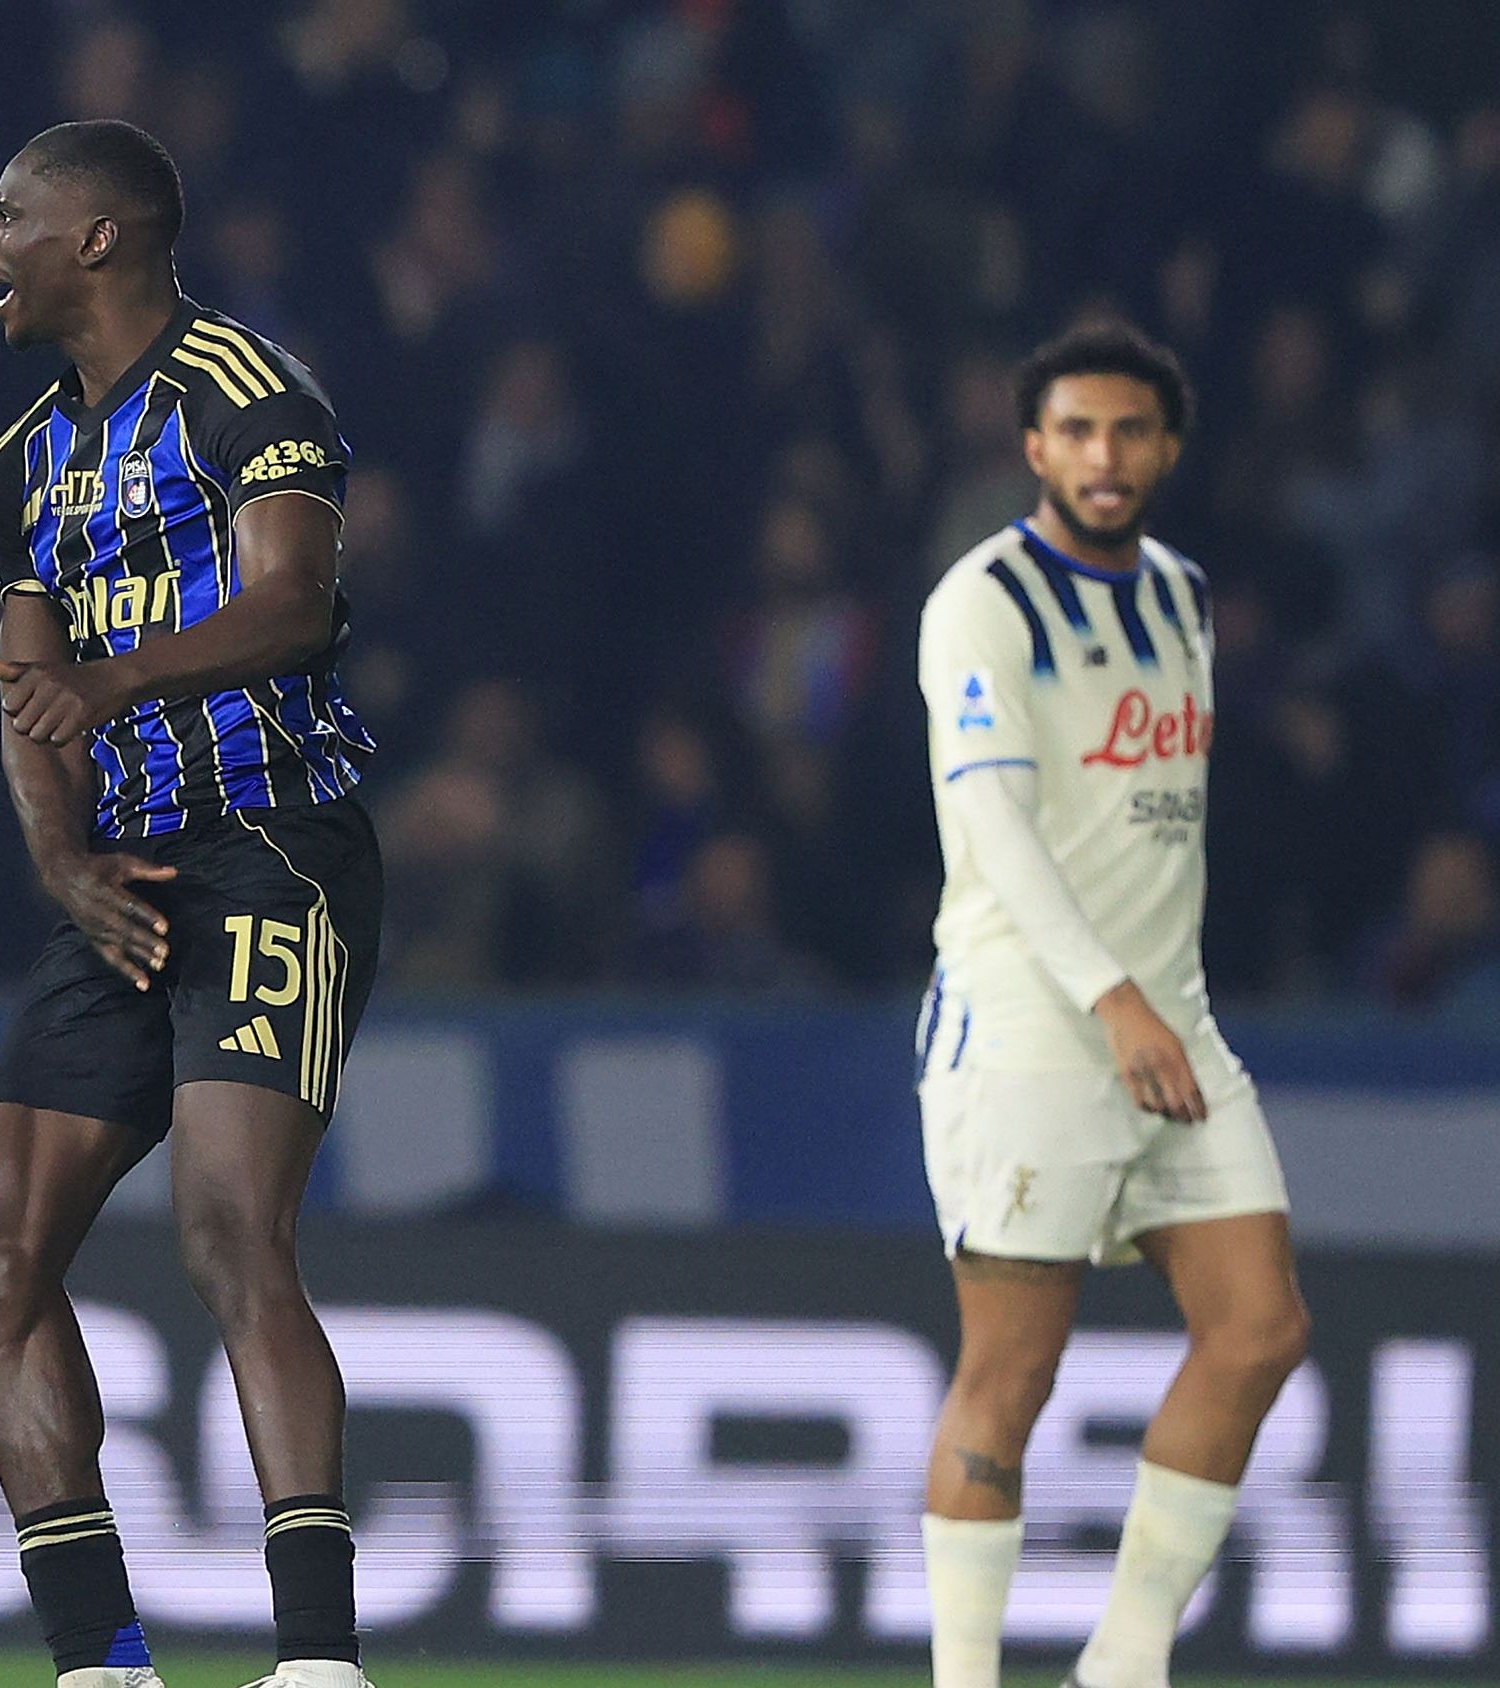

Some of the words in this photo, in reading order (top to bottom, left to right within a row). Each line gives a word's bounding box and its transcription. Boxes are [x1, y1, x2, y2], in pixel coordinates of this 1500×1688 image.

[125, 459, 149, 475] PISA
[249, 440, 325, 468] et365
[224, 914, 301, 1006] 15
